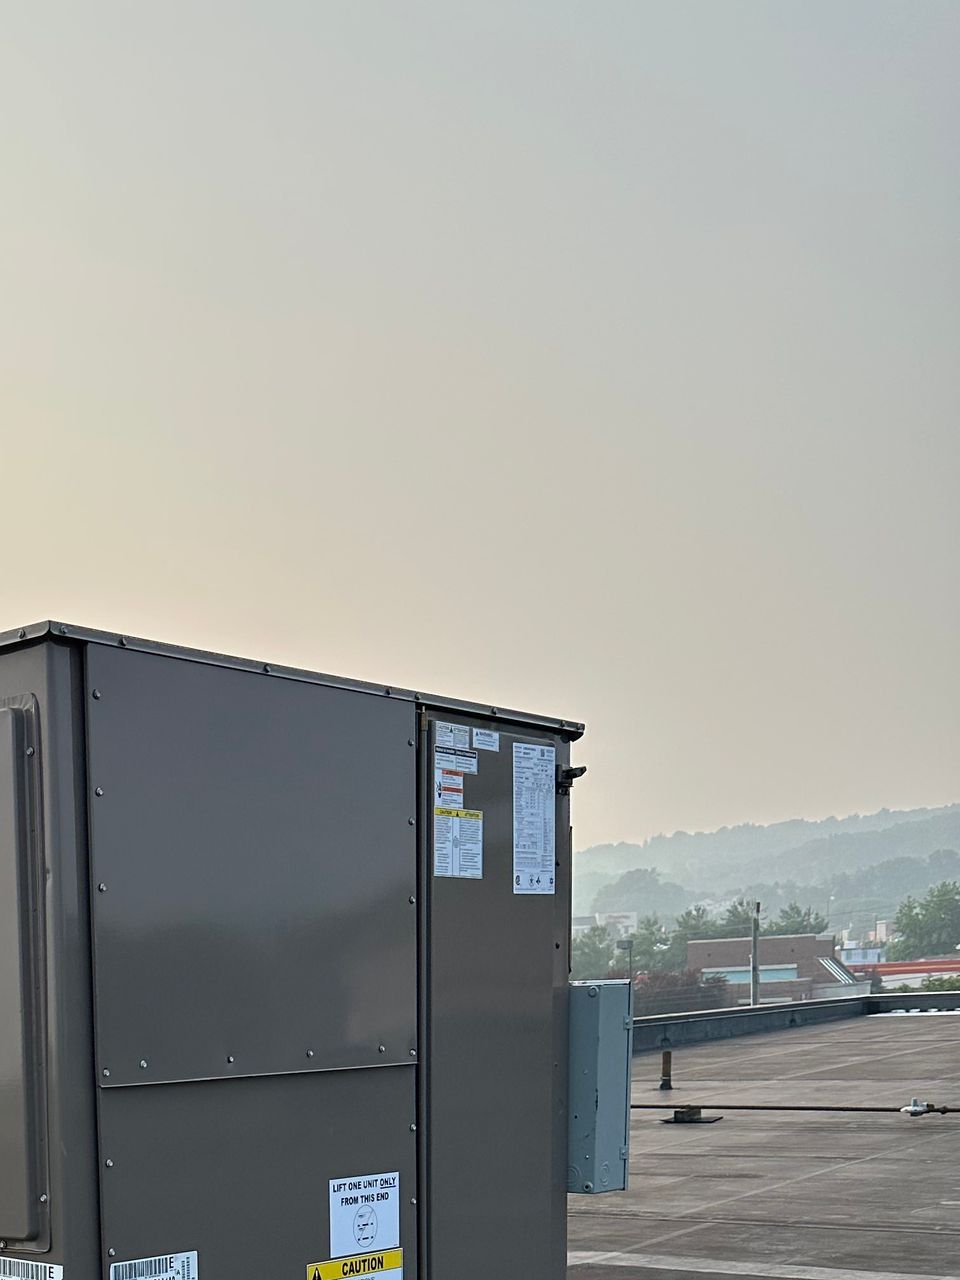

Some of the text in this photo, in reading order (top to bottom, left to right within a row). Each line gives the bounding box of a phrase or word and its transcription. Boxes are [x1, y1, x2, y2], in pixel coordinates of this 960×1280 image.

[332, 1177, 396, 1192] LIFT ONE UNIT ONLY
[341, 1192, 389, 1206] FROM THIS END
[169, 1257, 174, 1269] E
[342, 1256, 384, 1276] CAUTION
[49, 1266, 54, 1279] E
